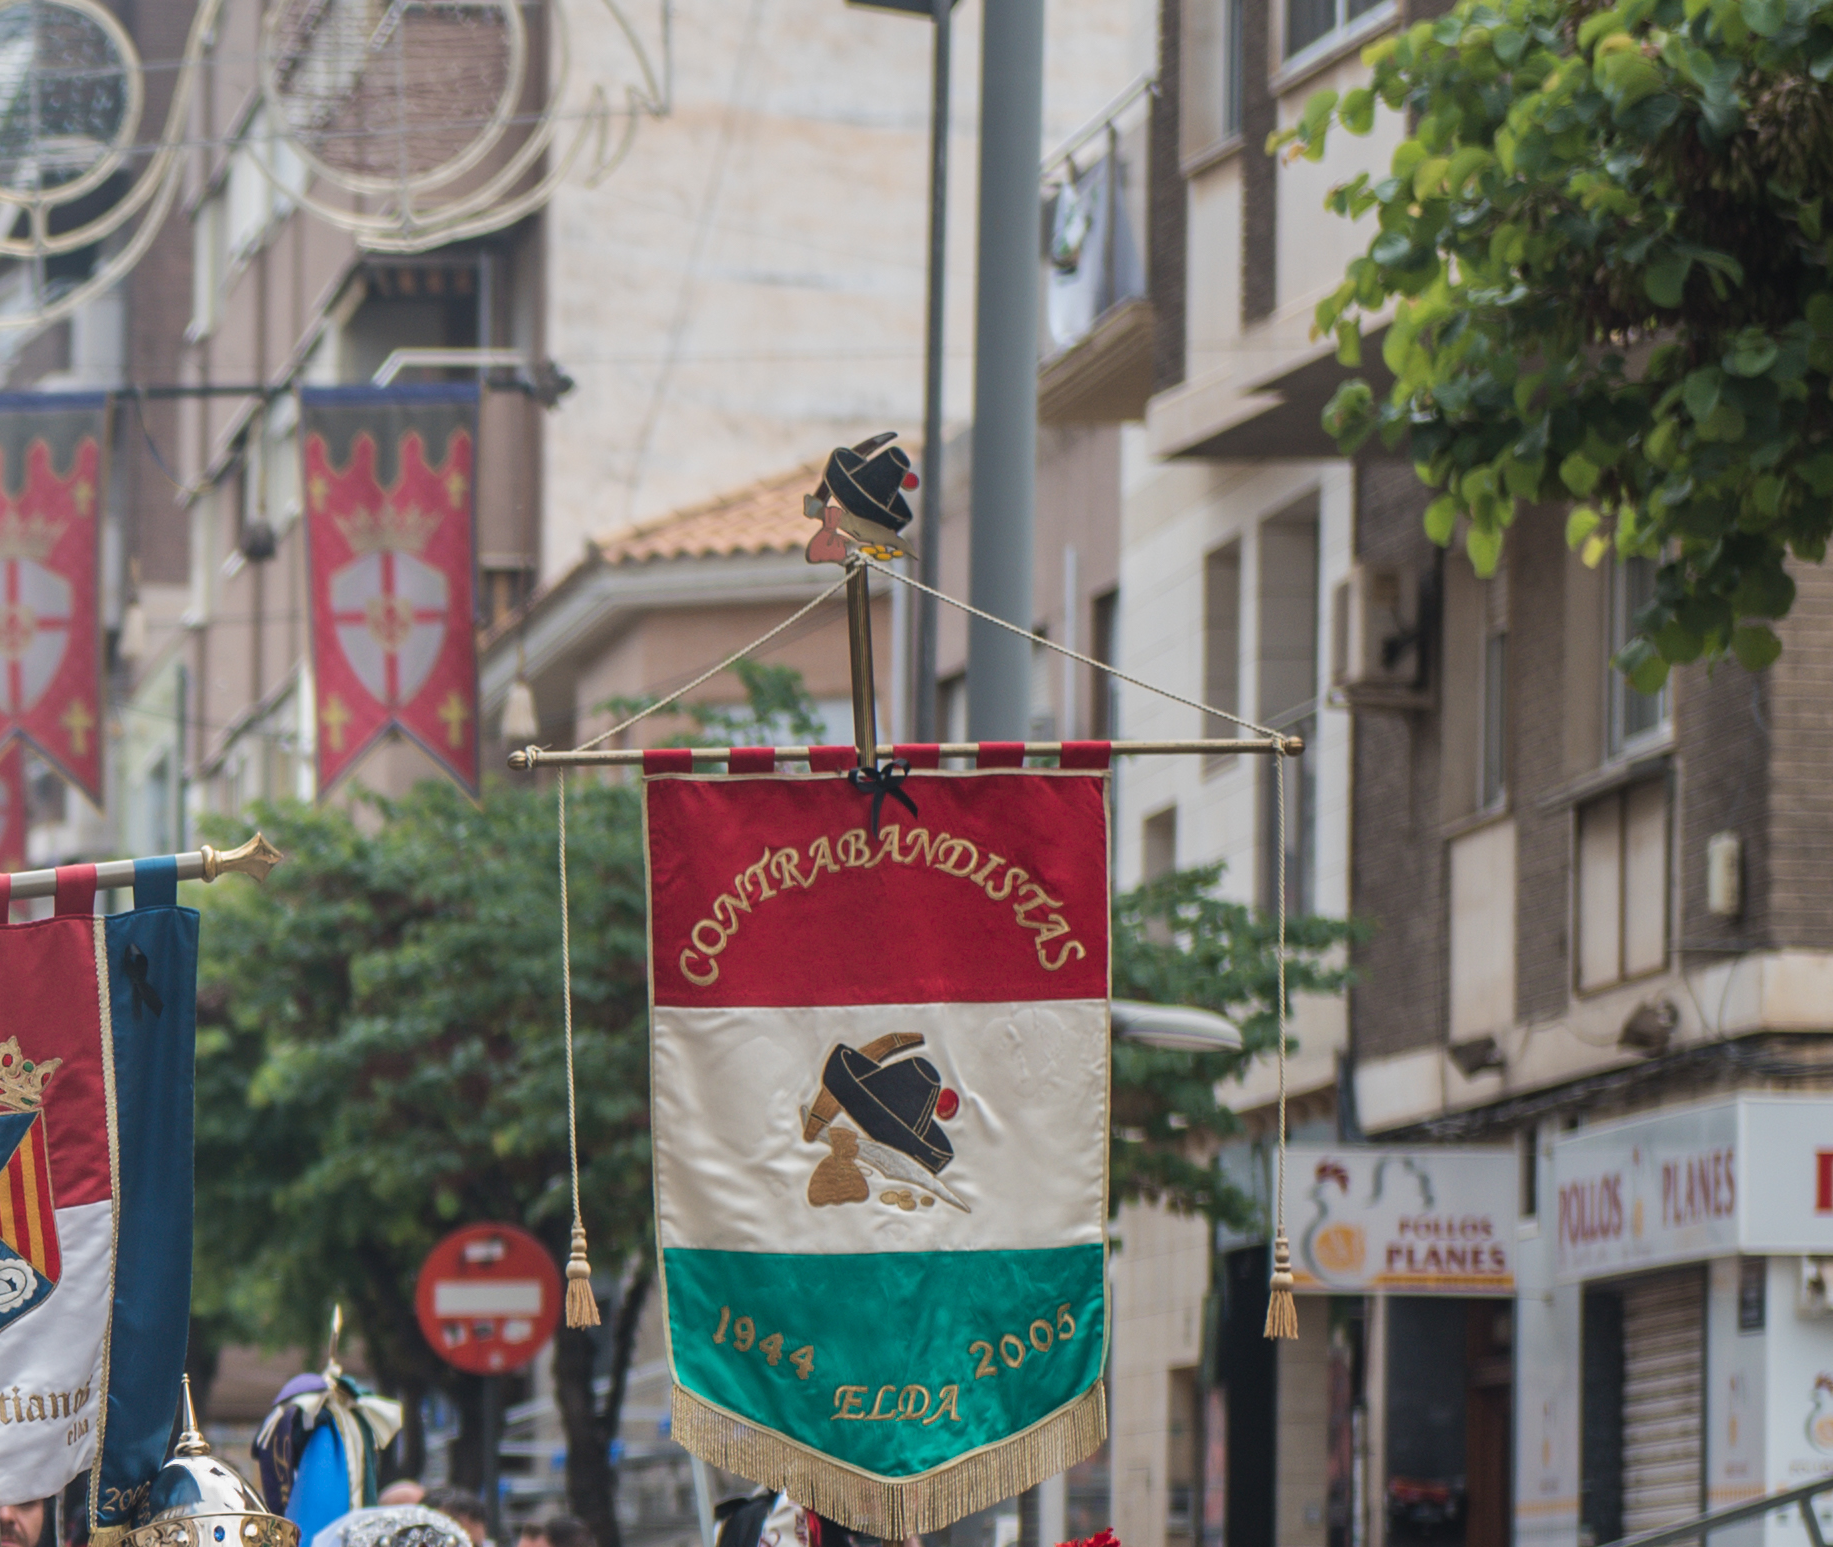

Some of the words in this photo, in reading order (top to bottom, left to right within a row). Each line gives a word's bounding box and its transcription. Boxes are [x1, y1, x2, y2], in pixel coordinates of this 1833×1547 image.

[678, 823, 1086, 987] CONTRABANDISTAS
[1398, 1213, 1493, 1241] POLLOS
[1558, 1172, 1624, 1249] POLLOS
[1661, 1147, 1735, 1230] PLANES
[1385, 1241, 1506, 1274] PLANES
[712, 1304, 815, 1381] 1944
[968, 1301, 1076, 1380] 2005
[830, 1383, 962, 1426] ELDA
